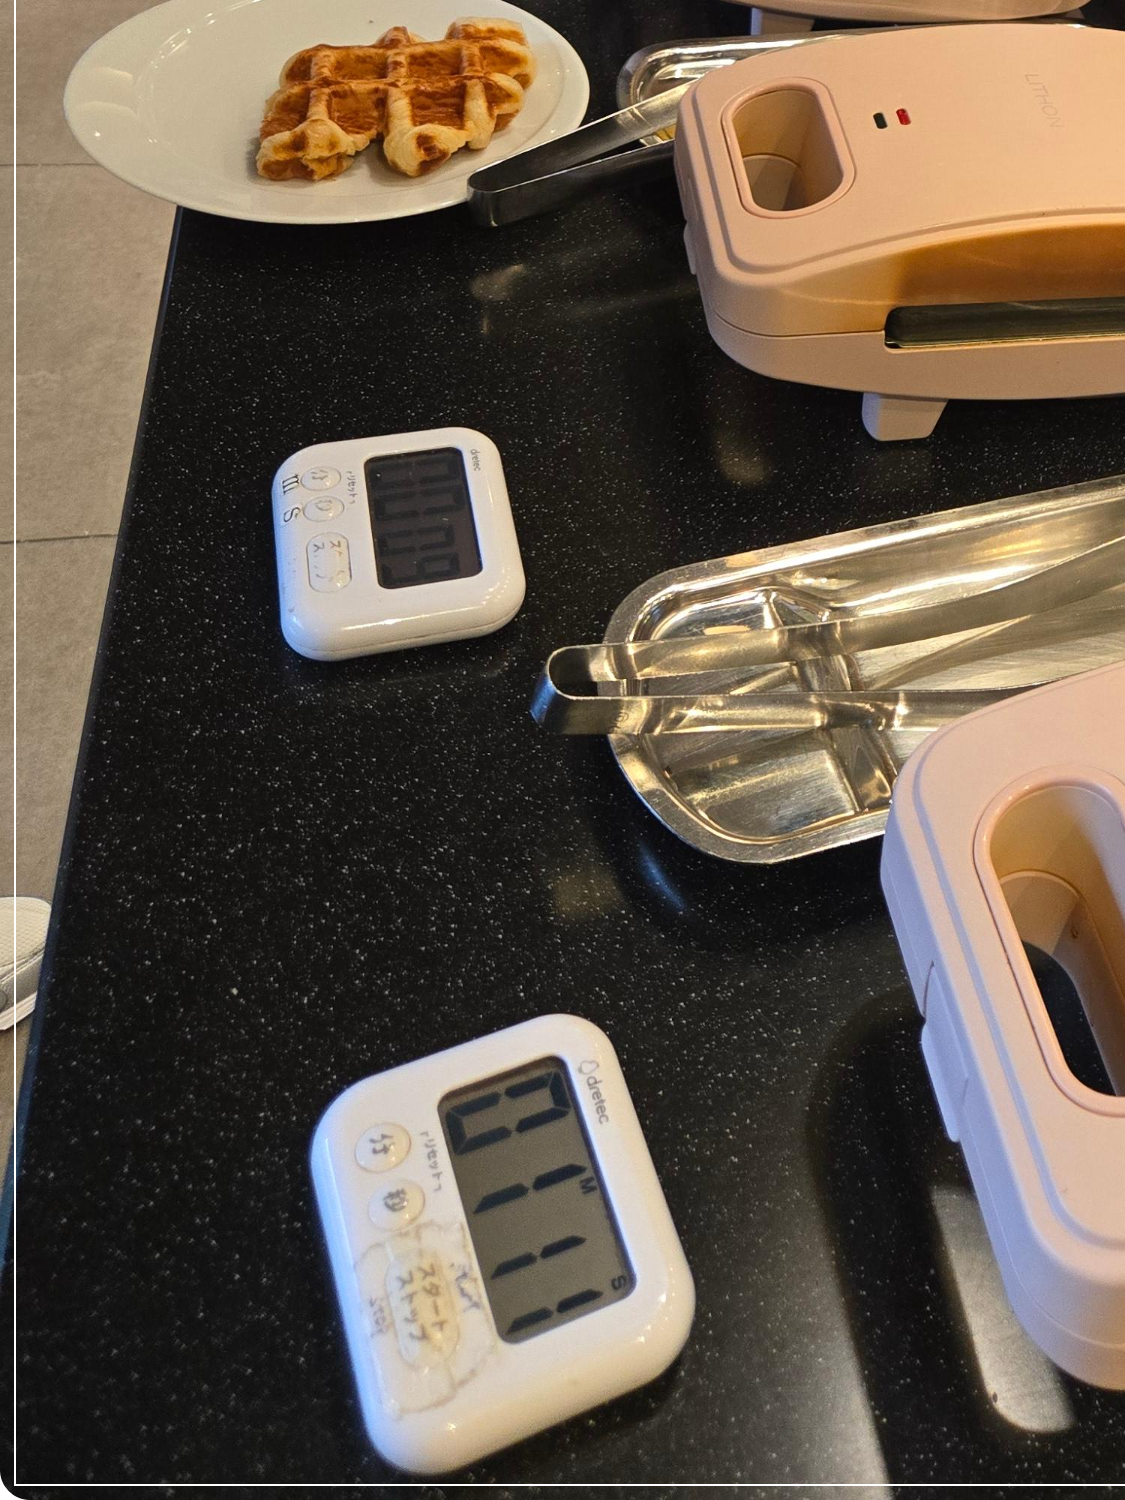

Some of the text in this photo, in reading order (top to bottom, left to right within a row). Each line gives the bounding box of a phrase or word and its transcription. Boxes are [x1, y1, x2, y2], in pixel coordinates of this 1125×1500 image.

[1024, 73, 1066, 128] LITHON
[470, 447, 481, 472] dretec
[586, 1073, 609, 1126] dretec
[369, 1132, 395, 1155] 分
[383, 1188, 408, 1213] 秒
[395, 1270, 428, 1342] ストップ
[419, 1263, 448, 1332] スタート
